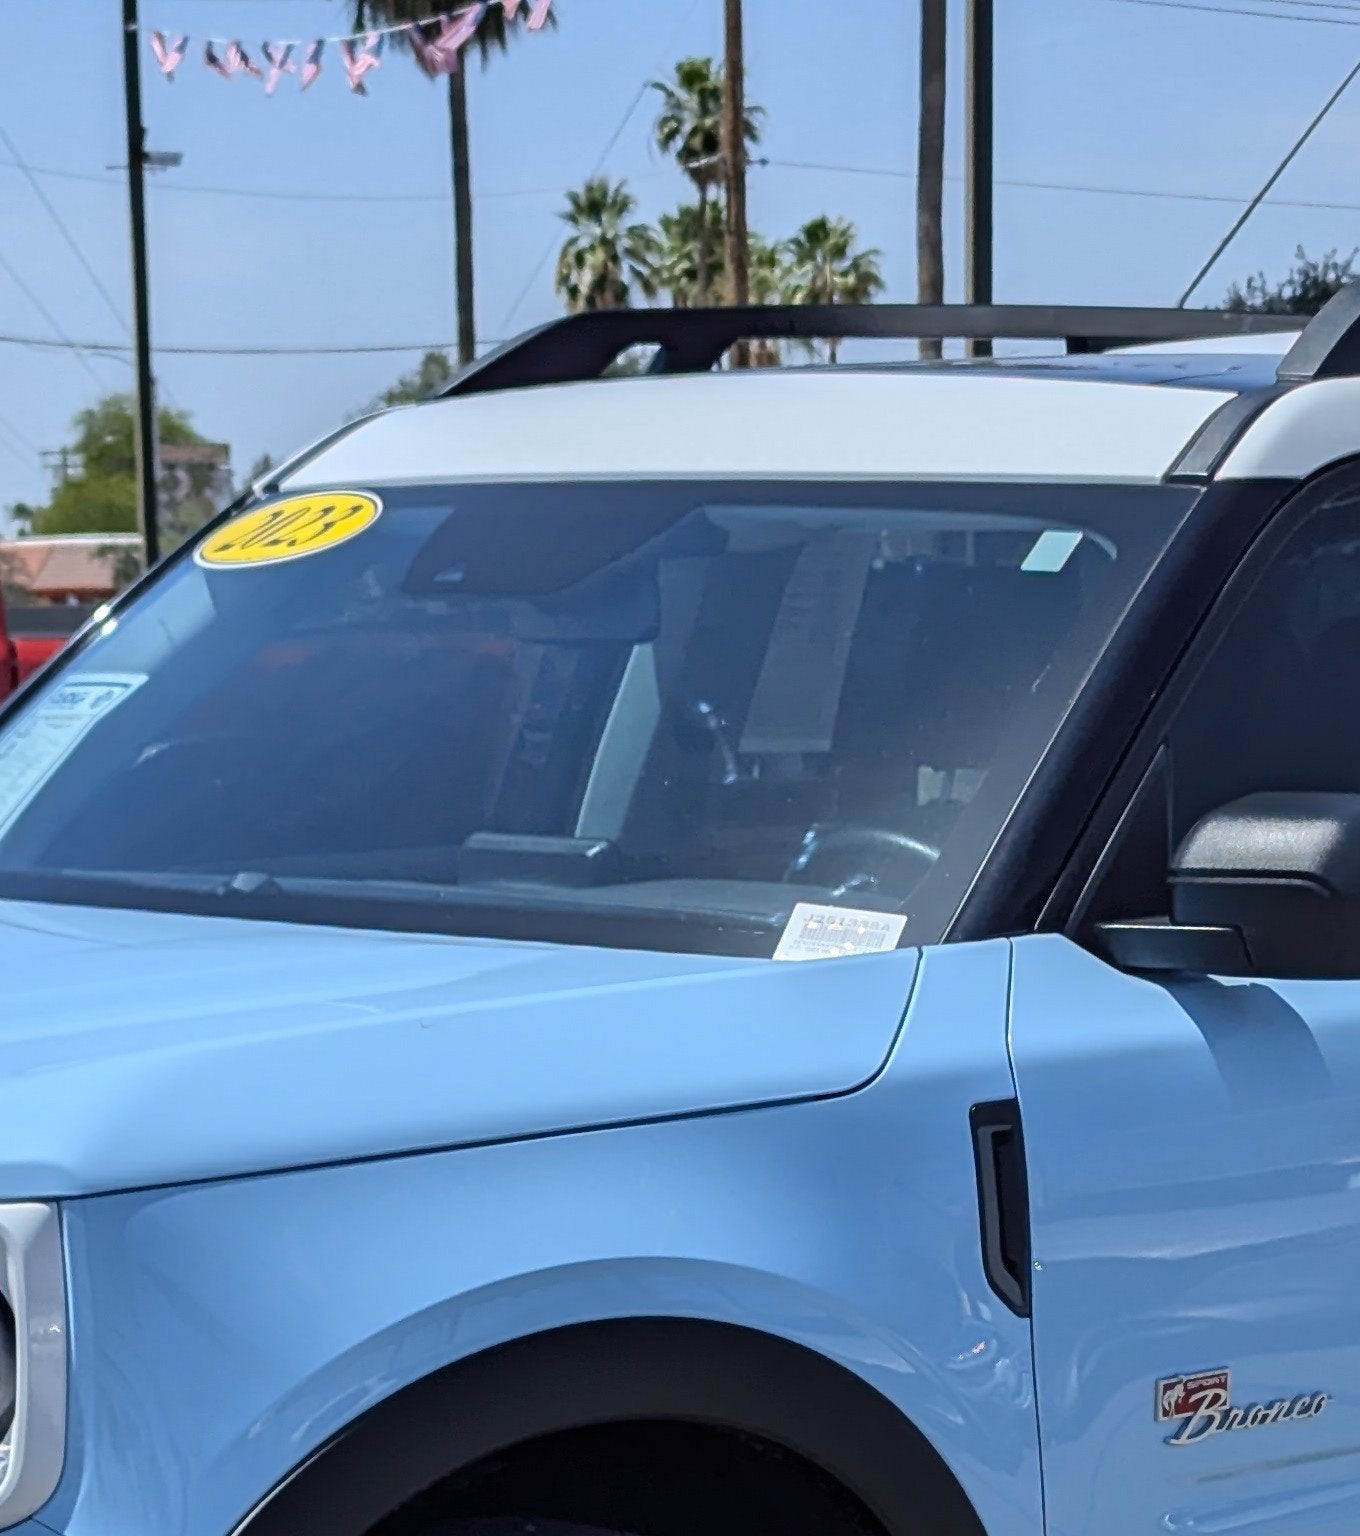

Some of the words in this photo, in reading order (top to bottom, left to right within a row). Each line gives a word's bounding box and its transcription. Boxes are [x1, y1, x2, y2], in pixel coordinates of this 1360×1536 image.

[213, 504, 364, 553] 2023
[1186, 1374, 1227, 1389] SPORT
[1165, 1389, 1329, 1445] Bronco
